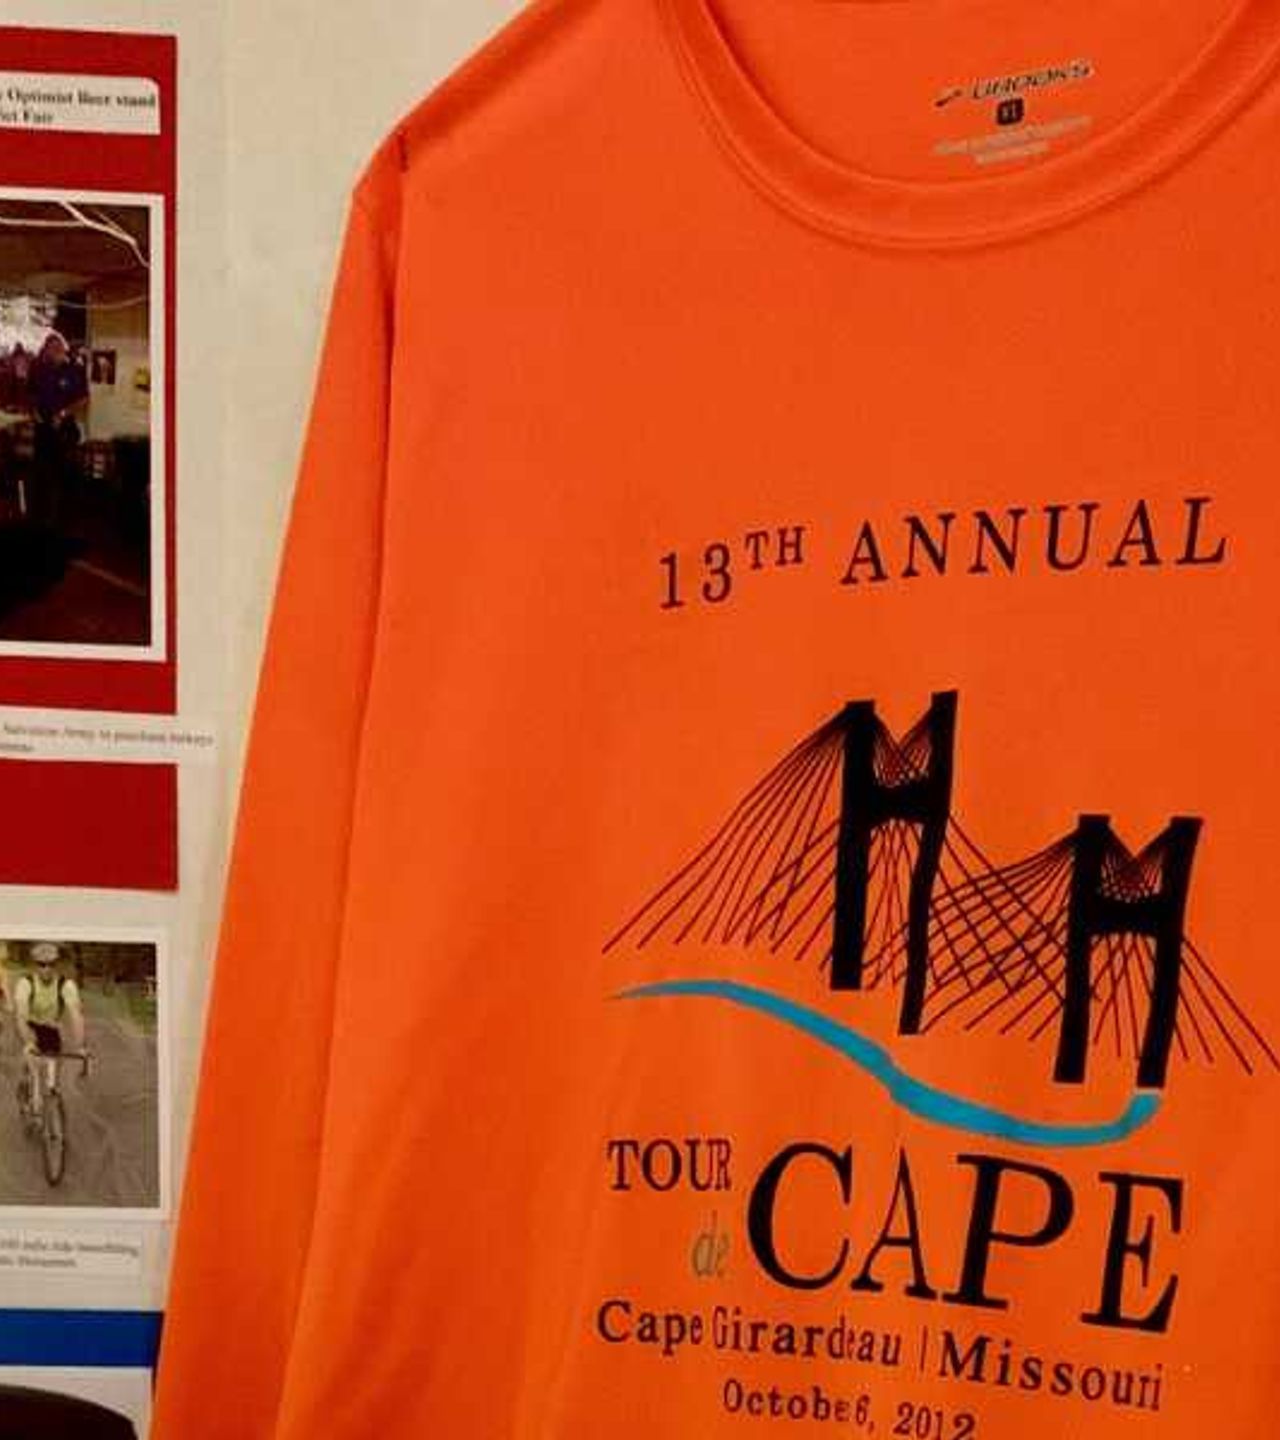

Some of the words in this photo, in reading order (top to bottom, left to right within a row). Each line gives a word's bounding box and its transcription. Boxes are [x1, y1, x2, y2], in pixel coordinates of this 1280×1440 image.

[23, 109, 54, 123] Fair
[78, 89, 110, 105] Beer
[116, 90, 156, 107] stand
[659, 526, 808, 609] 13TH
[840, 497, 1228, 586] ANNUAL
[607, 1138, 732, 1192] TOUR
[747, 1141, 1184, 1334] CAPE
[597, 1300, 703, 1357] Cape
[712, 1306, 902, 1368] Girardeau
[937, 1332, 1163, 1412] Missouri
[723, 1378, 851, 1422] Octobe
